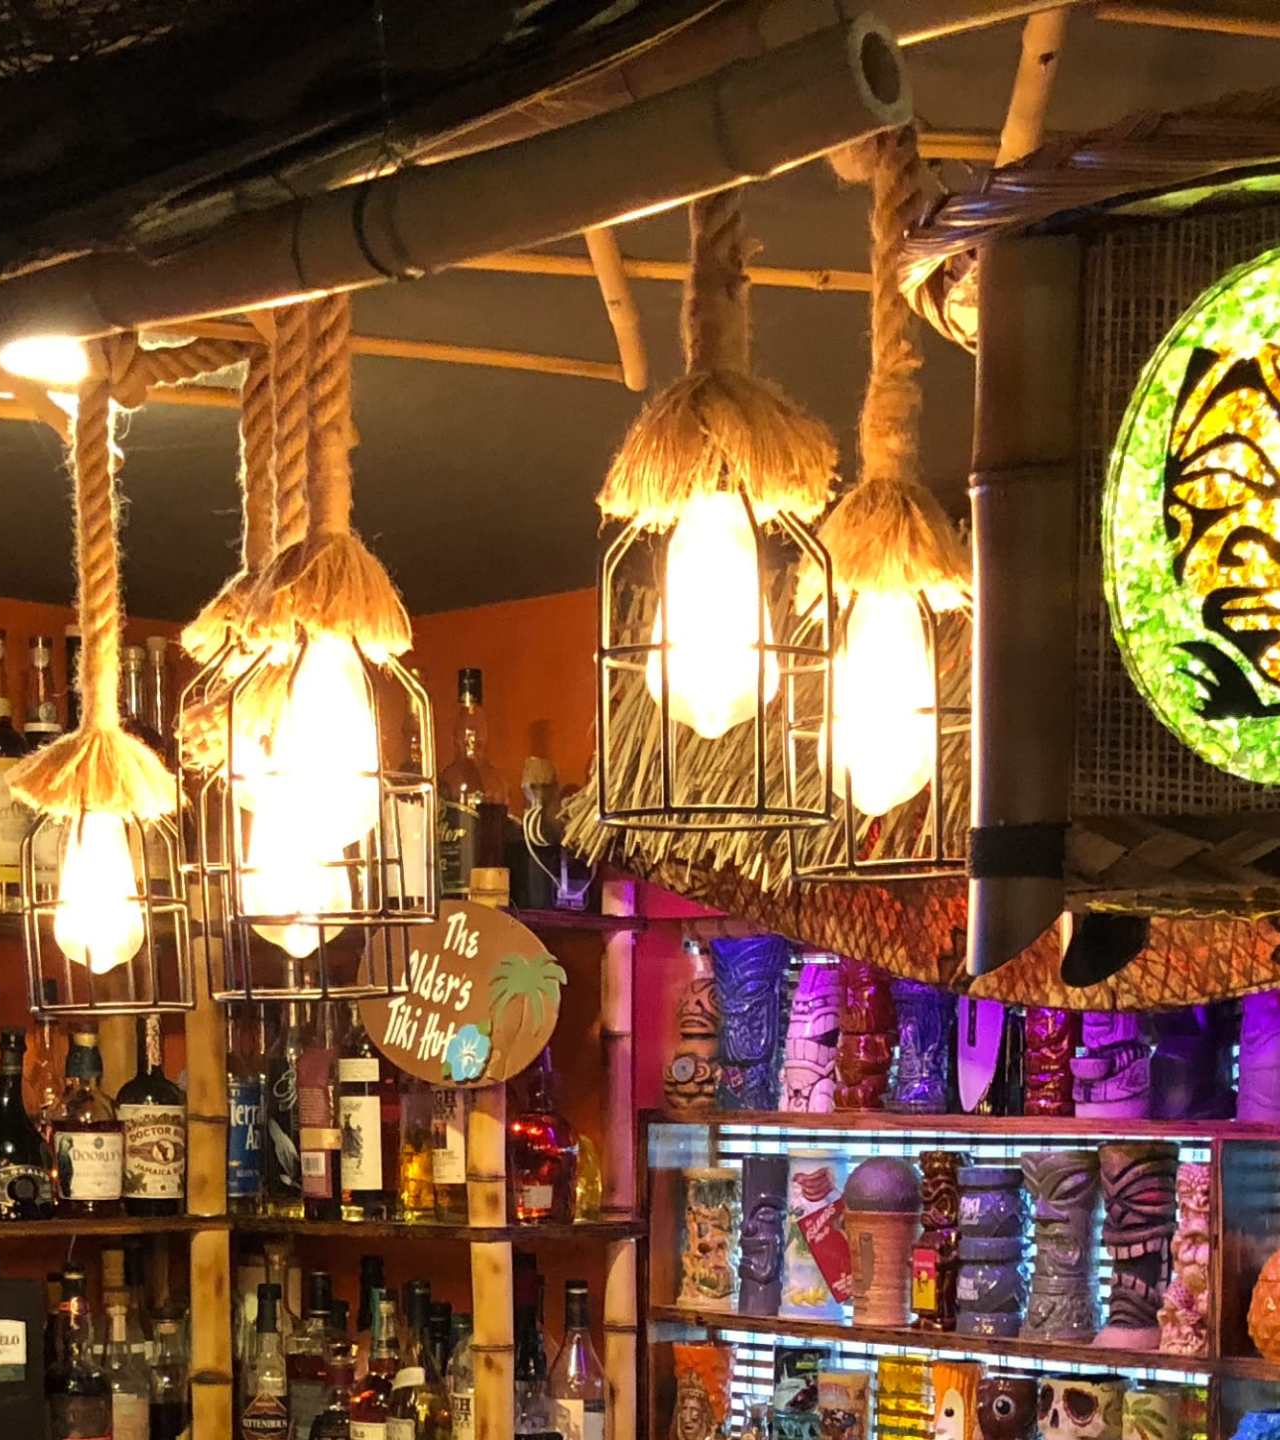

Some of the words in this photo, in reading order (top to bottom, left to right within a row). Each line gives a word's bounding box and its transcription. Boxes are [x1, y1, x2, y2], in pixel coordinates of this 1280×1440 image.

[443, 911, 481, 959] The
[383, 996, 423, 1051] Tiki
[417, 1013, 457, 1064] Hut
